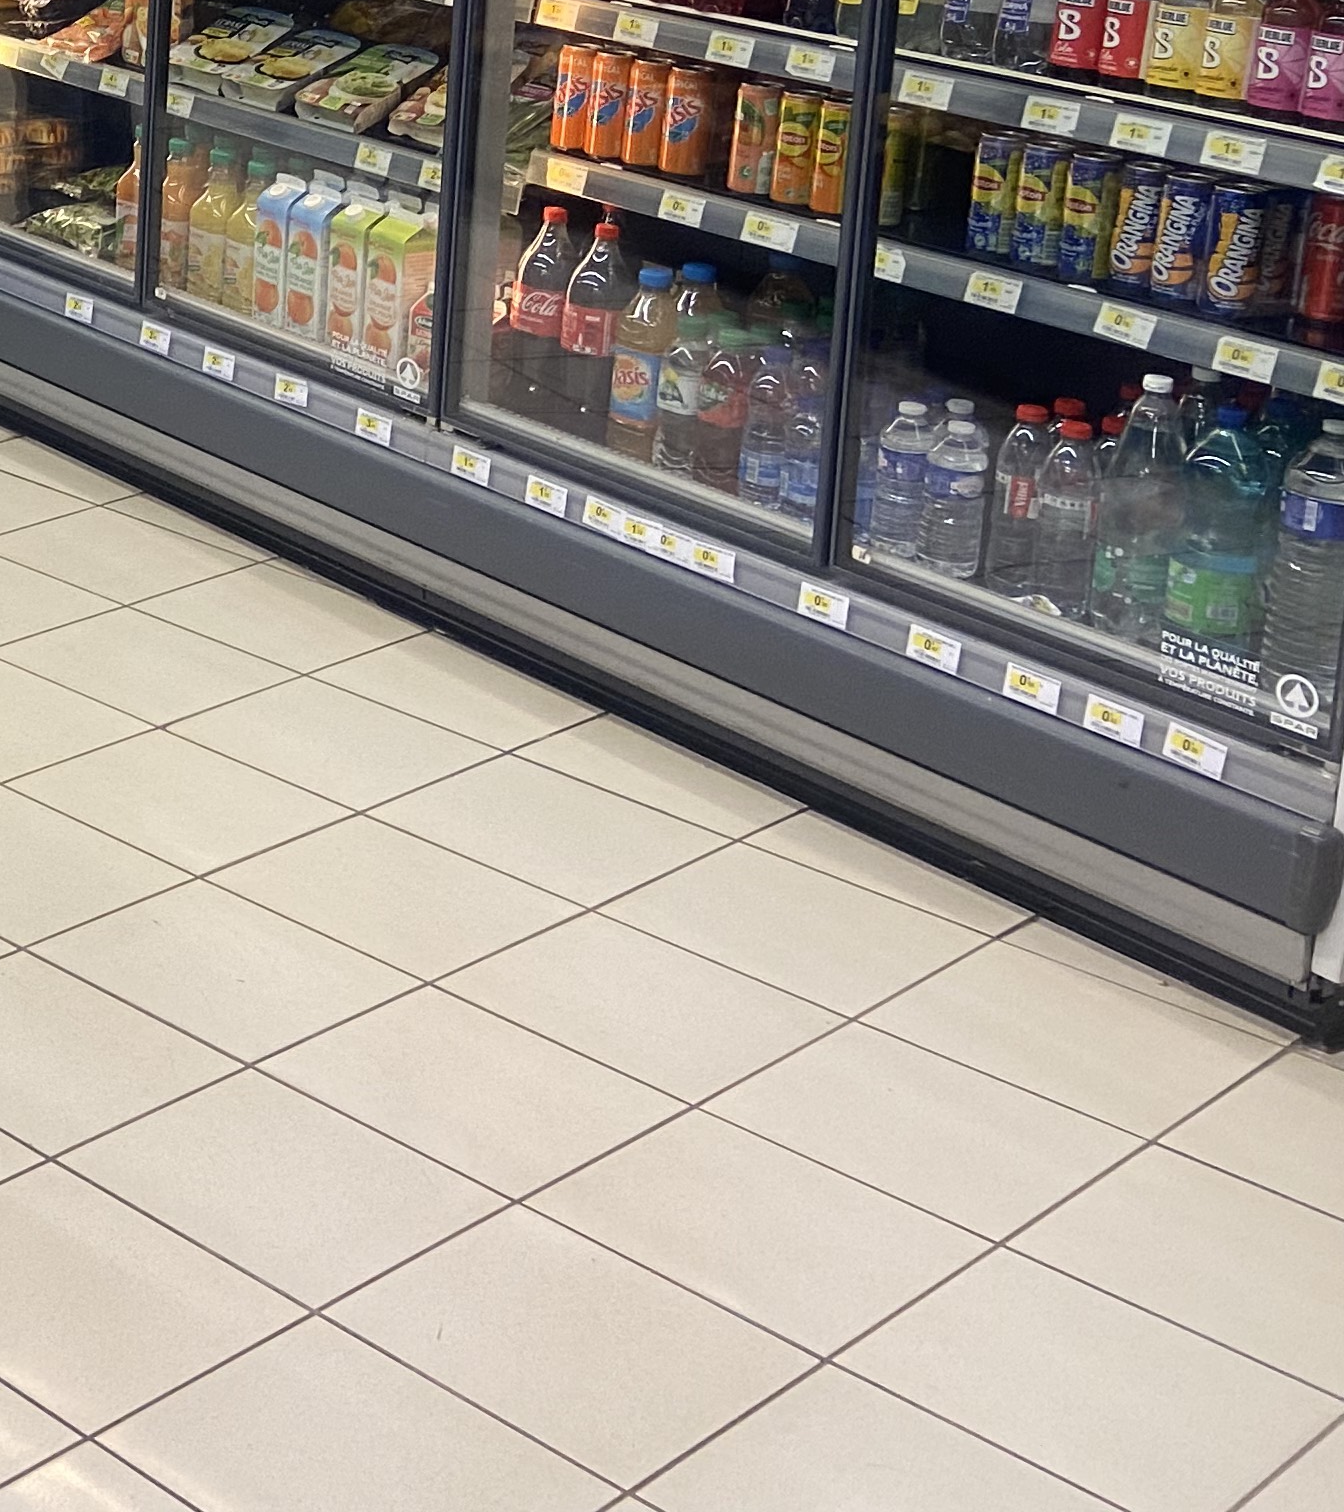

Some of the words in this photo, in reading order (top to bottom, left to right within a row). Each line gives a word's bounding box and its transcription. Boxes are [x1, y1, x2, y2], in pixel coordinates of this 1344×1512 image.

[1112, 185, 1161, 271] ORANGINA
[1152, 195, 1200, 282] ORANGINA
[1210, 208, 1265, 298] ORANGINA
[521, 291, 561, 317] Cola
[393, 386, 421, 404] SPAR
[1161, 641, 1175, 656] ET
[1179, 648, 1195, 663] LA
[1162, 630, 1192, 649] POUR
[1195, 642, 1209, 655] LA
[1212, 648, 1261, 673] QUALITÉ
[1161, 665, 1185, 682] VOS
[1188, 673, 1257, 708] PRODUITS
[1271, 712, 1318, 738] SPAR
